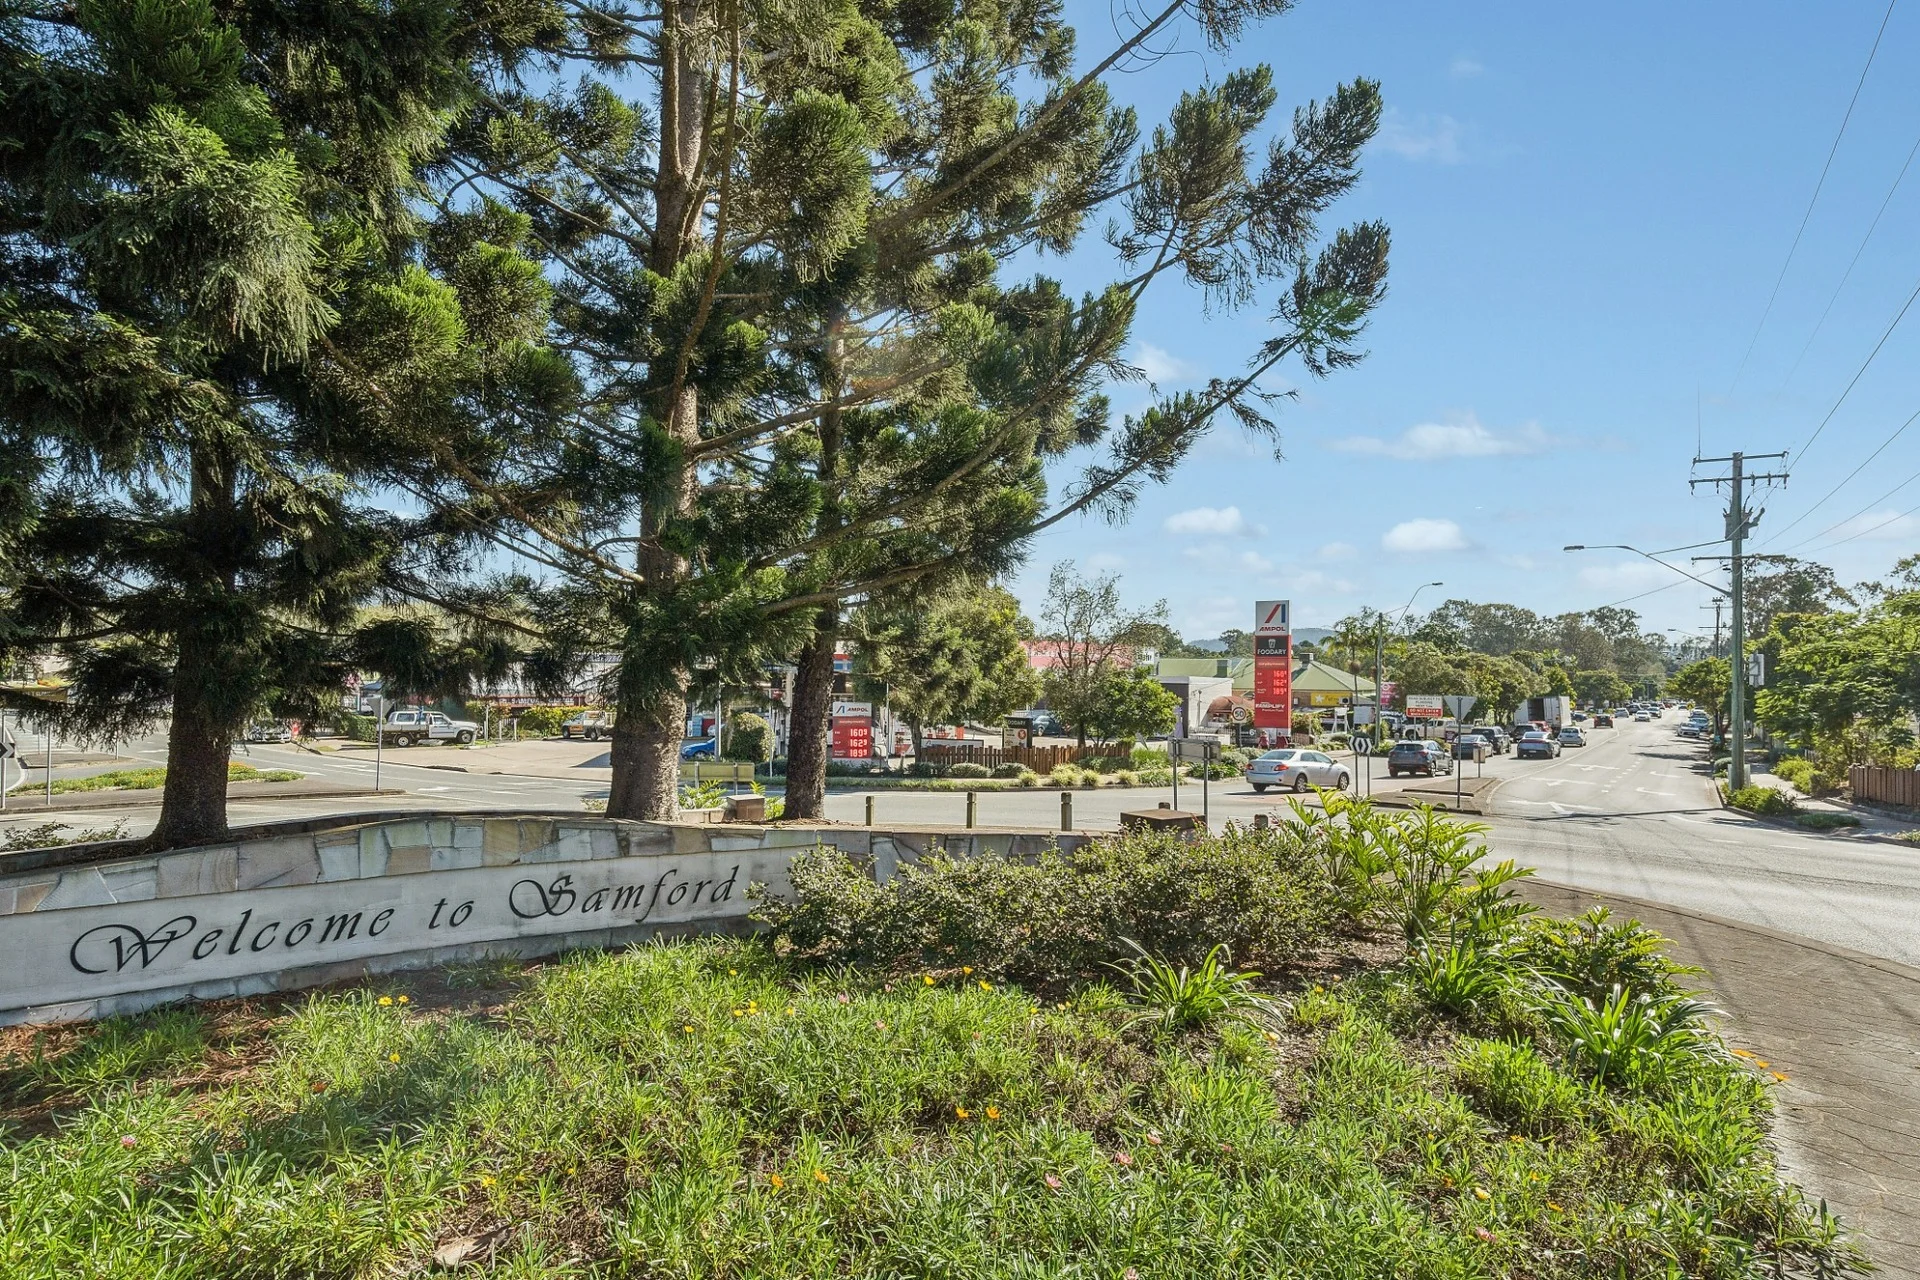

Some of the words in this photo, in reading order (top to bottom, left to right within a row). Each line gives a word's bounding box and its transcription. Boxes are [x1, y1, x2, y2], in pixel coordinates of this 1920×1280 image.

[70, 907, 395, 974] Welcome
[428, 897, 475, 930] to
[508, 864, 740, 923] Samford
